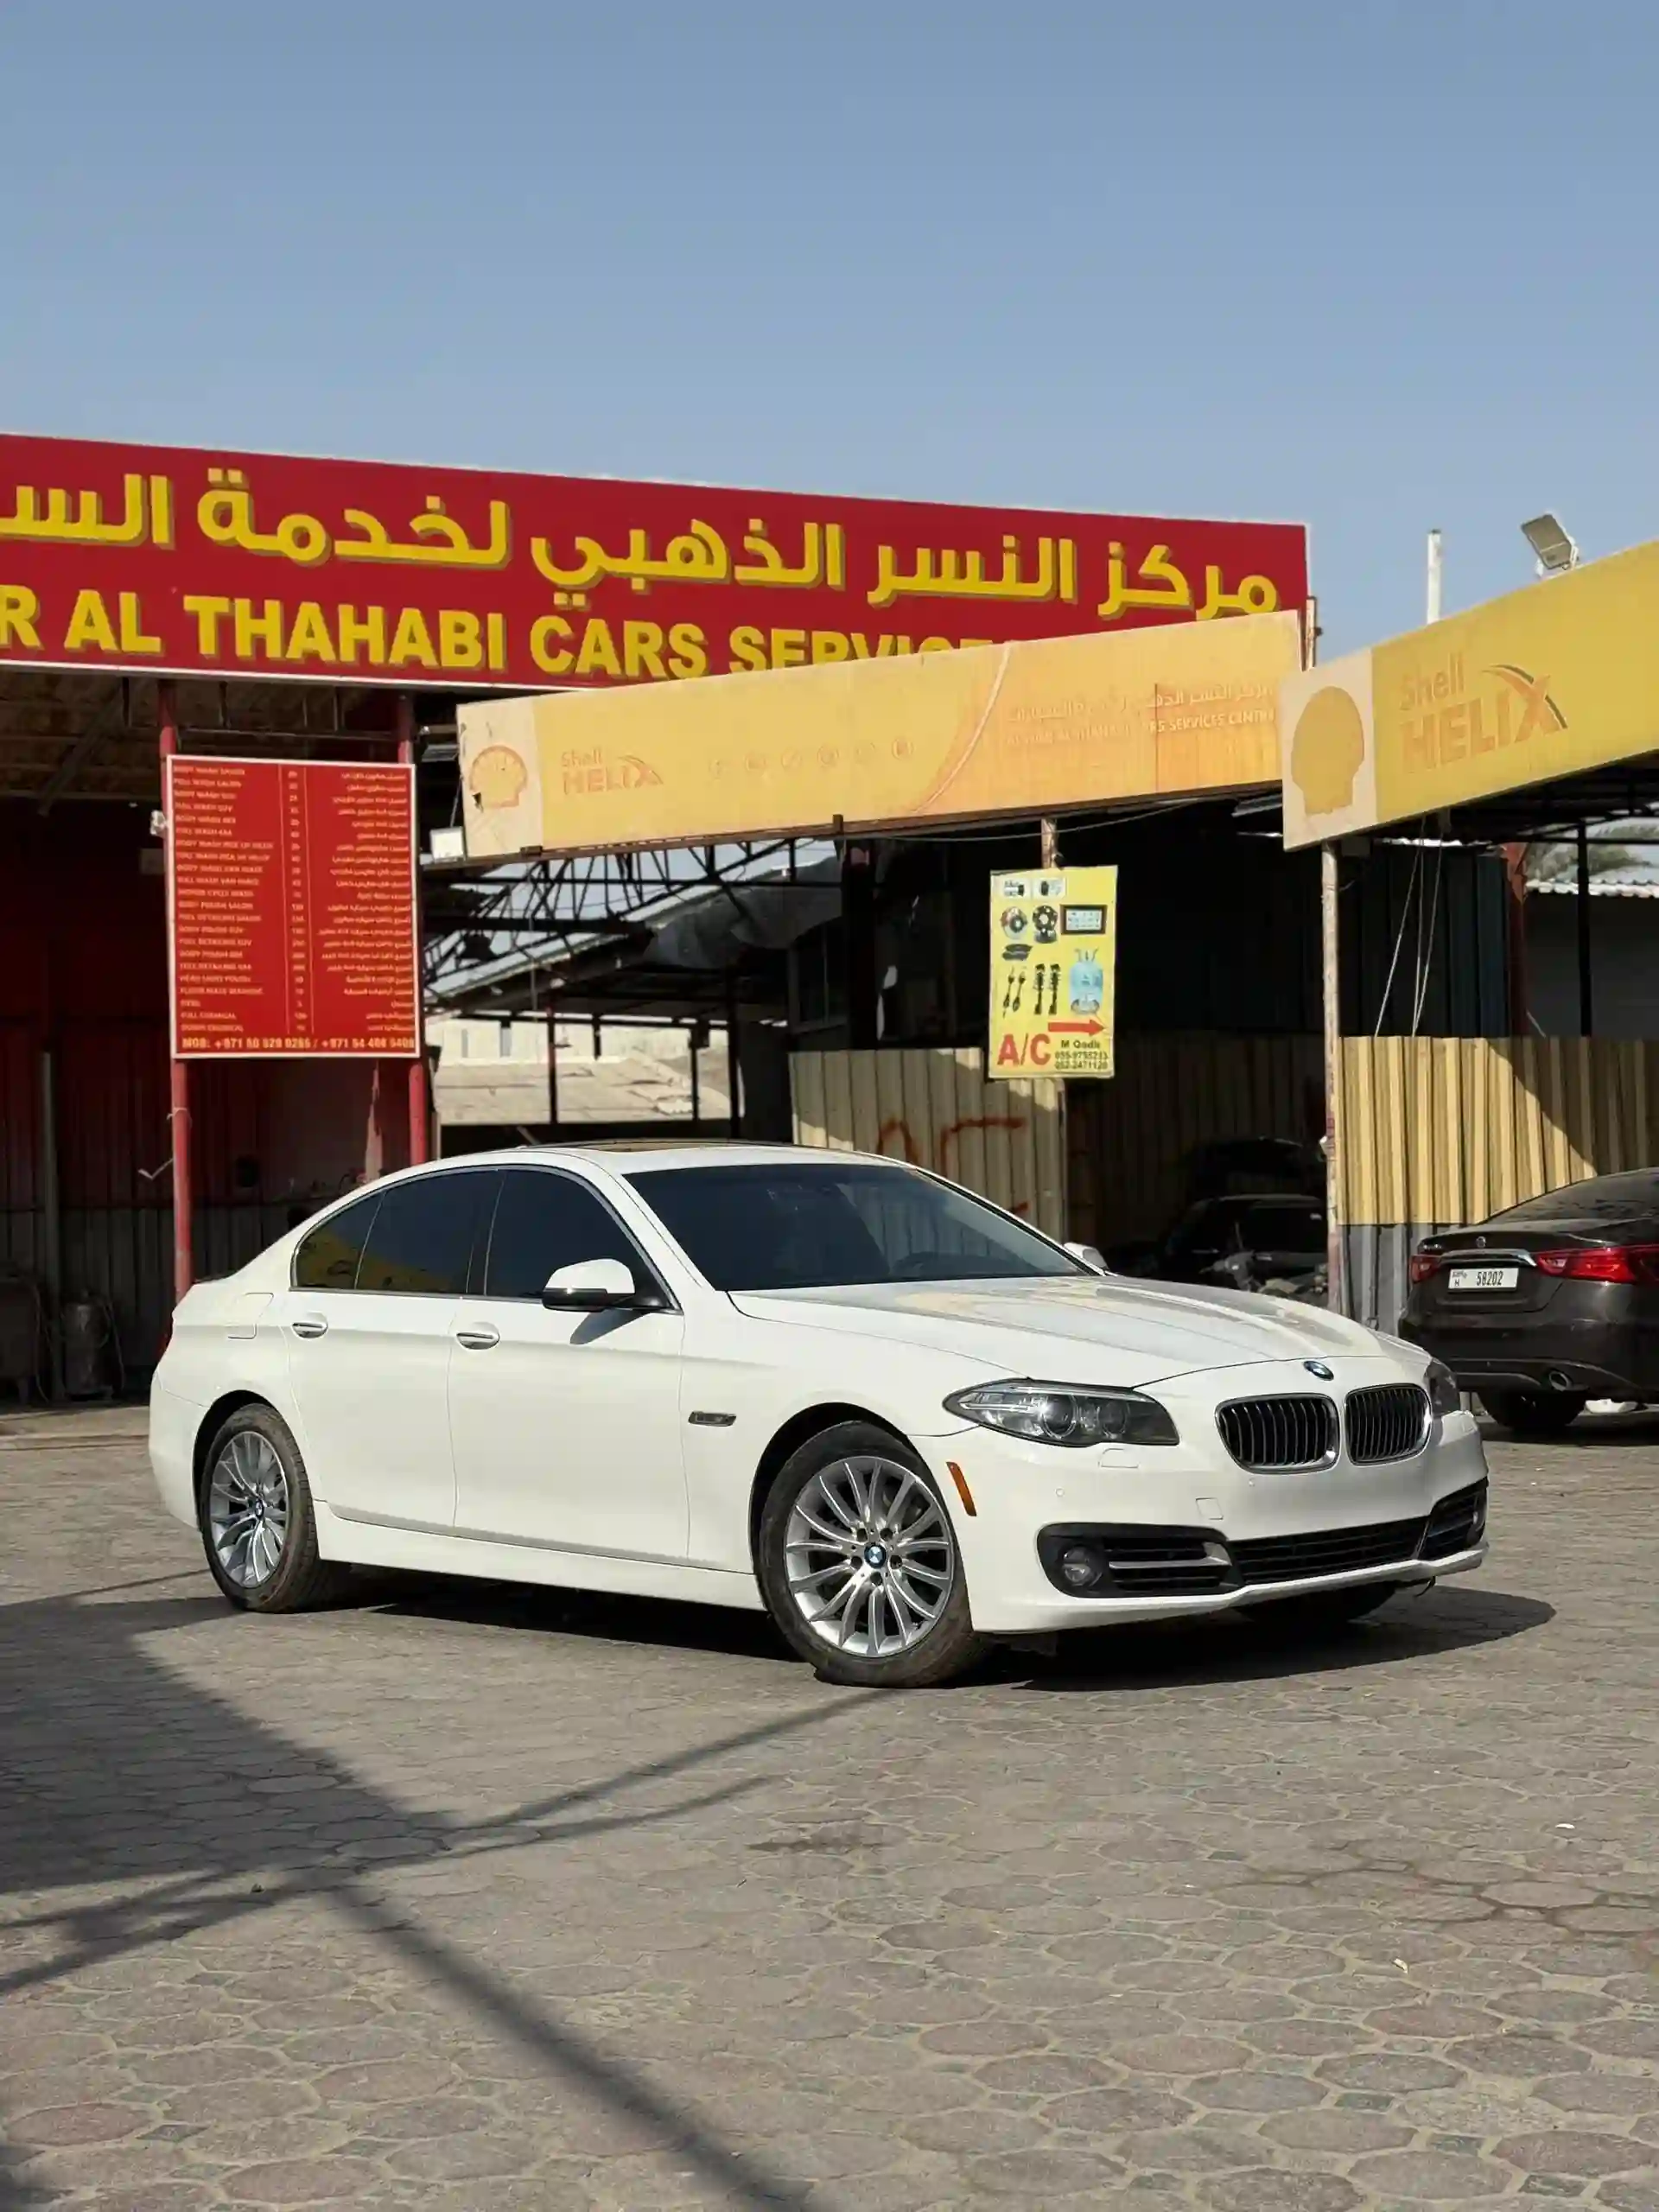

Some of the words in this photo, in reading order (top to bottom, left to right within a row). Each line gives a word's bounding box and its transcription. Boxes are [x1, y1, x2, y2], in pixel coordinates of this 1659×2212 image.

[196, 467, 512, 569] لخدمة
[530, 517, 847, 608] الذهبي
[867, 535, 1078, 607] النسر
[1096, 540, 1279, 622] مركز
[64, 589, 163, 654] AL
[183, 595, 508, 672] THAHABI
[530, 614, 709, 680] CARS
[1399, 652, 1465, 711] Shell
[1400, 664, 1568, 774] HELIX
[997, 1033, 1052, 1066] A/C
[1061, 1039, 1070, 1048] M
